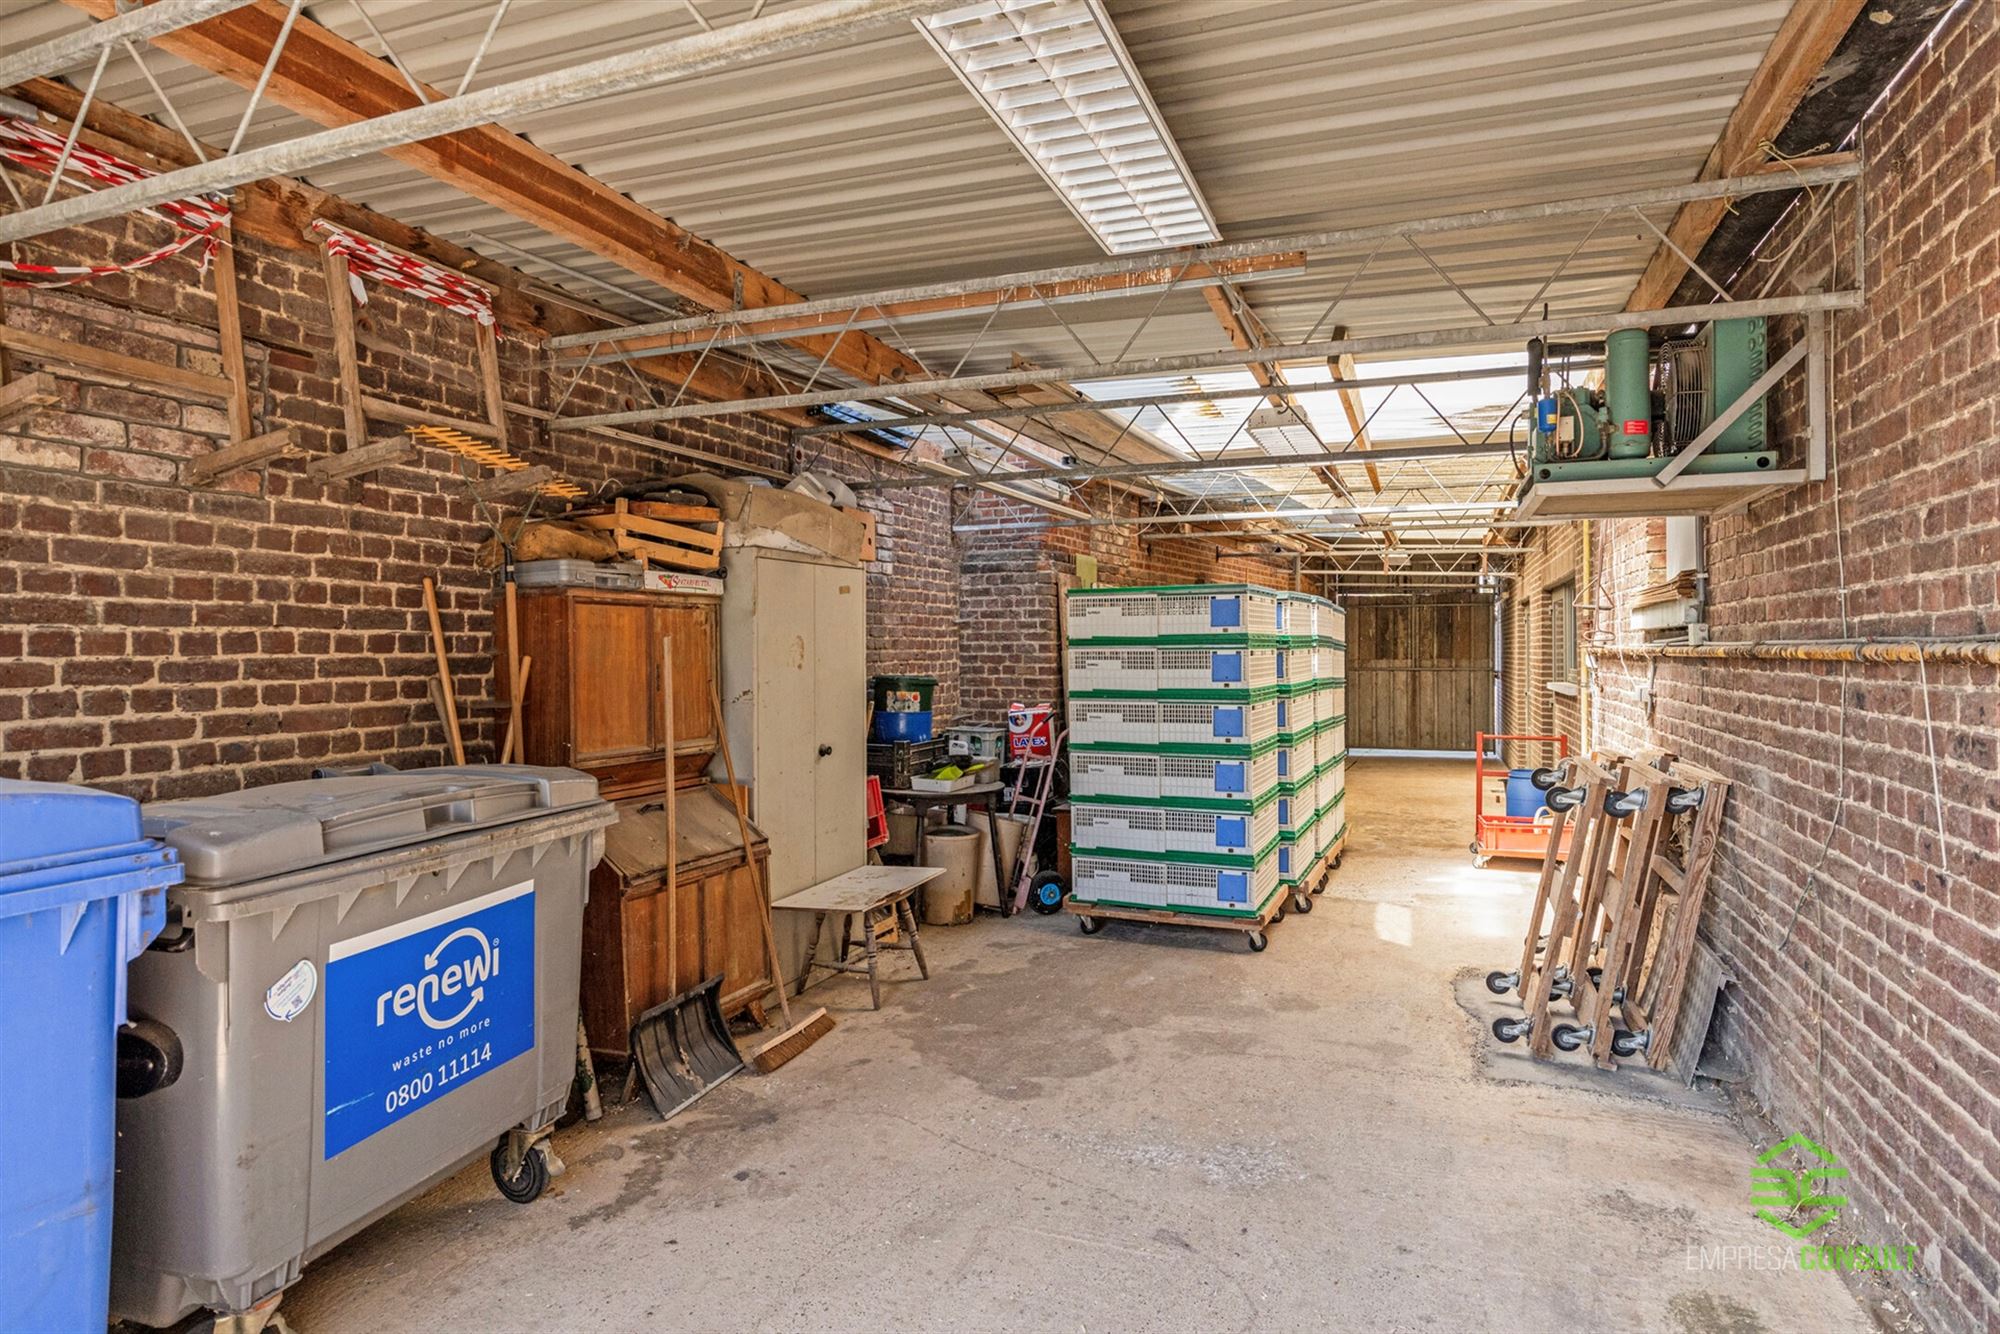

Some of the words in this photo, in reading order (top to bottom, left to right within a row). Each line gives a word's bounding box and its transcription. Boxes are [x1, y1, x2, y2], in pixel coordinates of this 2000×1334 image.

[376, 927, 500, 1030] renewi
[385, 1072, 433, 1113] 0800
[438, 1042, 492, 1087] 11114
[392, 1045, 432, 1072] waste
[438, 1036, 454, 1049] no
[459, 1018, 490, 1039] more
